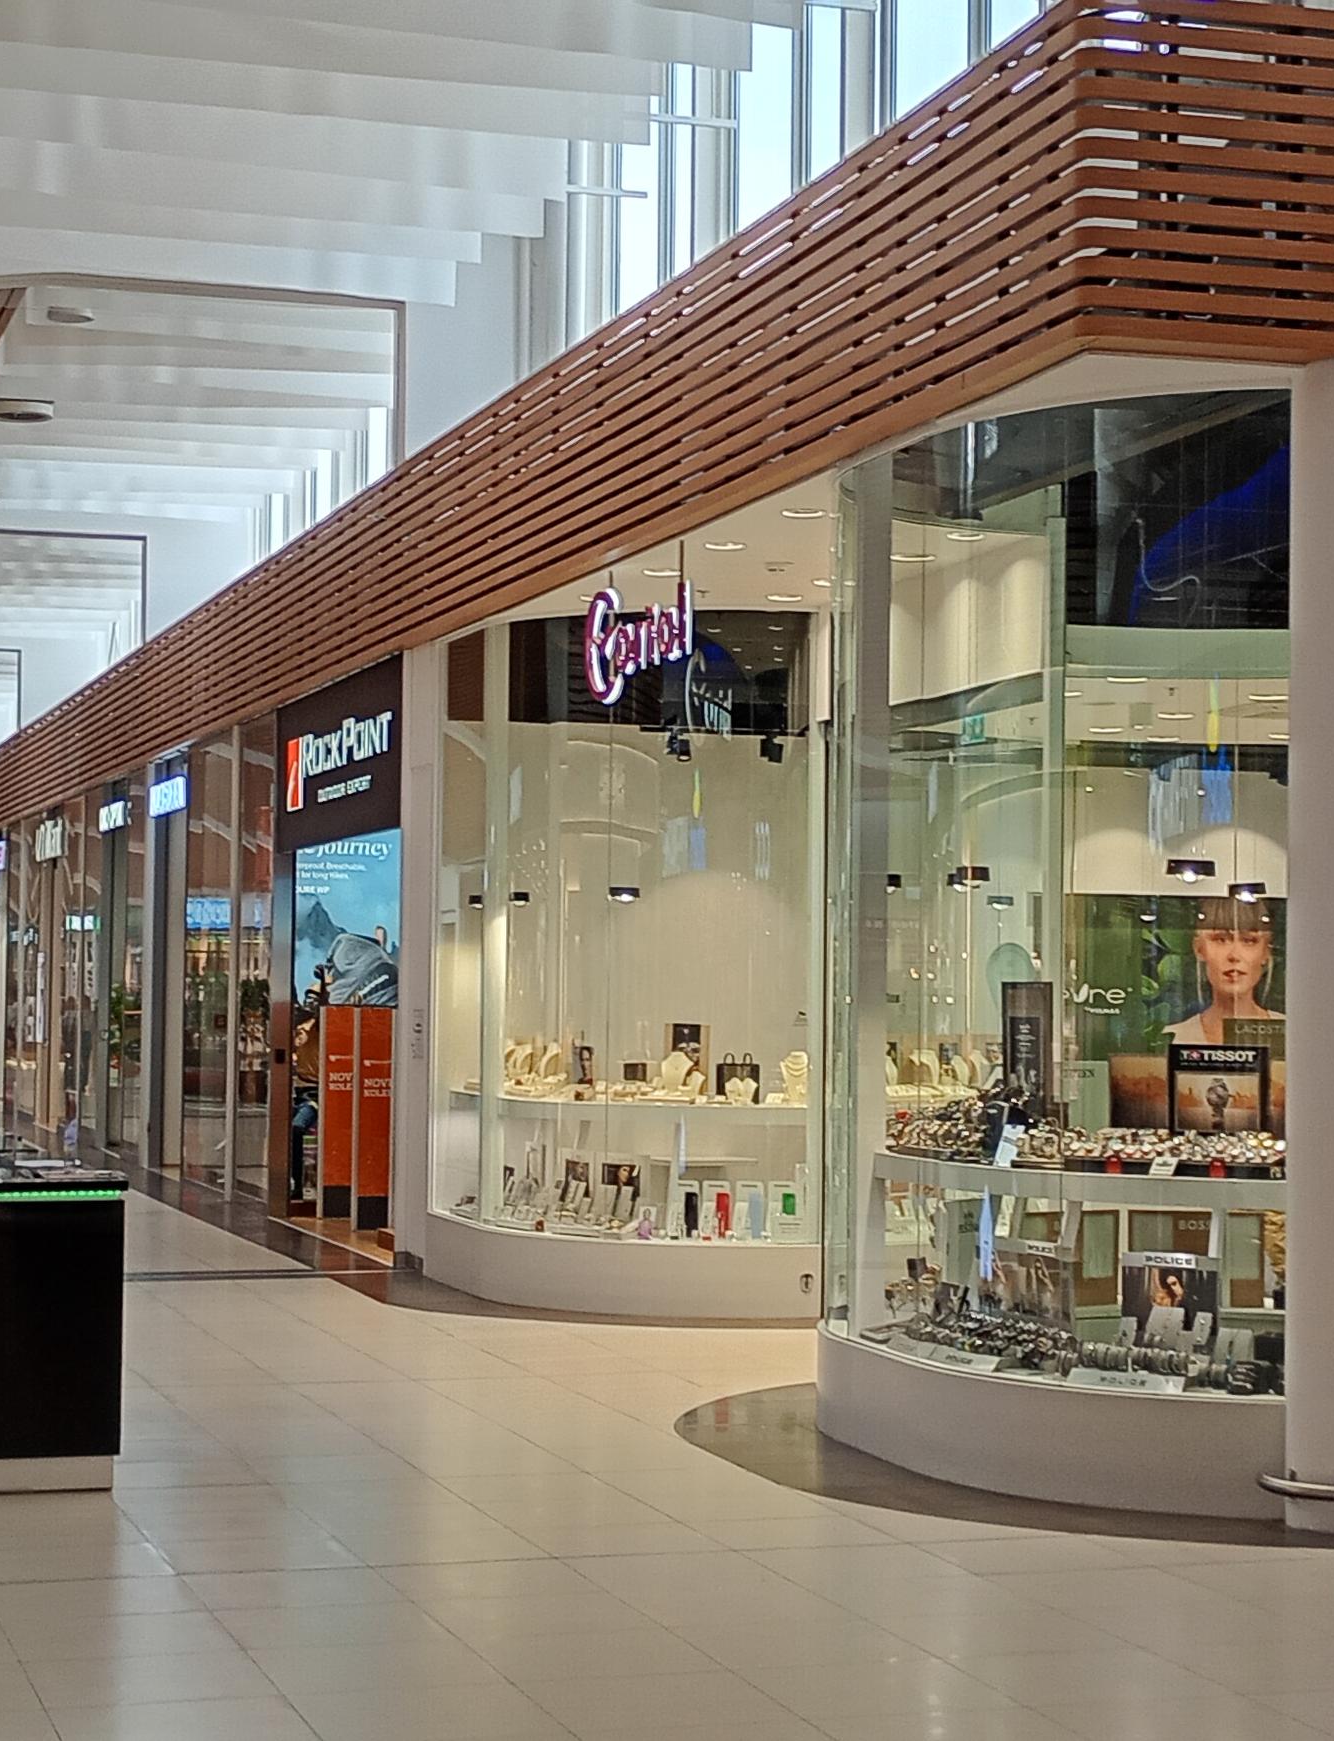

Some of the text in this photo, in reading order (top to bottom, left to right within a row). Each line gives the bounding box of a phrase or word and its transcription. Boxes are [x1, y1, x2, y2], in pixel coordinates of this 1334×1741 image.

[1235, 1024, 1285, 1034] LACOST
[1204, 1050, 1258, 1062] TISSOT
[1144, 1253, 1193, 1266] POLICE
